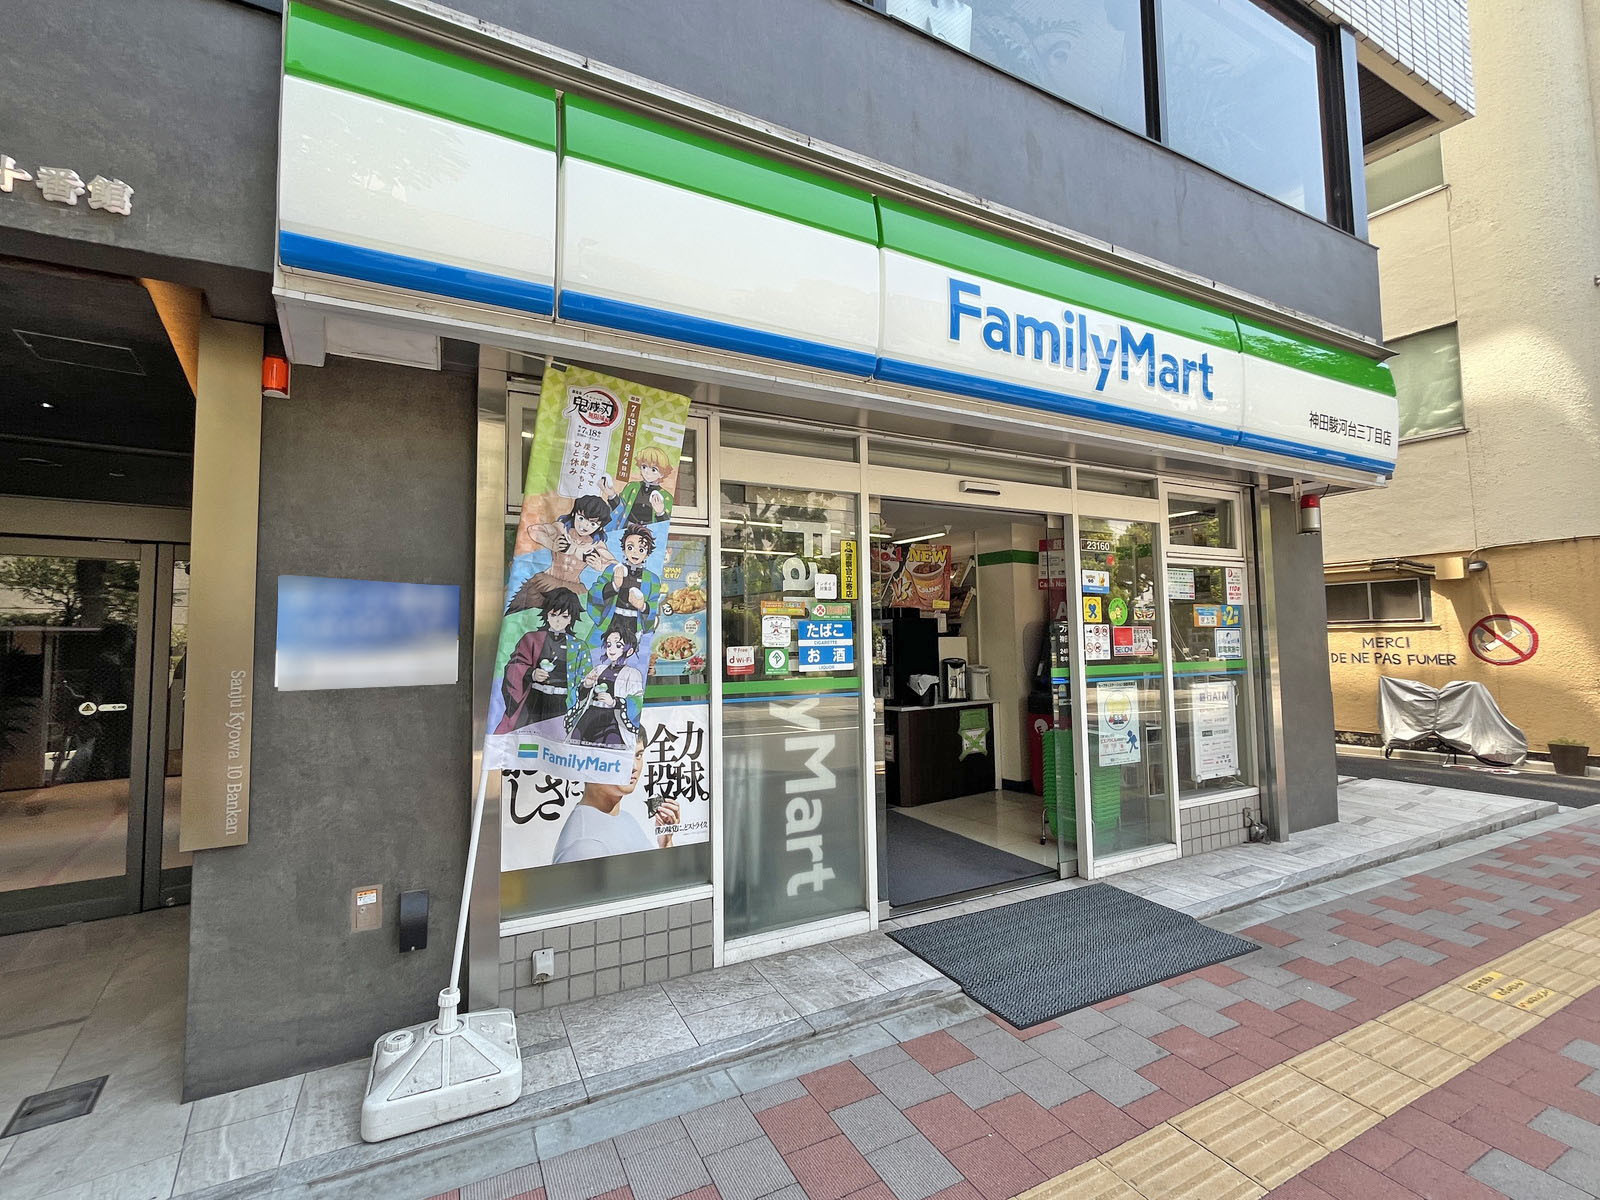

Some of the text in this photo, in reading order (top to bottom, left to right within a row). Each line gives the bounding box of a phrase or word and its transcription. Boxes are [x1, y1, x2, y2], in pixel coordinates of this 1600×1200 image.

[948, 277, 1215, 400] FamilyMart
[1308, 410, 1392, 446] 神田駿河台三丁目店
[568, 440, 587, 476] ひと休み
[908, 547, 948, 563] NEW
[1086, 541, 1110, 551] 23160
[806, 623, 845, 638] たばこ
[1362, 636, 1410, 649] MERCI
[736, 656, 752, 664] Wi-Fi
[807, 647, 846, 663] お酒
[1330, 652, 1457, 666] DE NE PAS FUMER
[230, 670, 246, 708] Sanju
[225, 711, 246, 760] Kyowa
[645, 720, 704, 764] 全力
[542, 747, 621, 773] FamilyMart
[643, 761, 710, 803] 投球。
[225, 782, 243, 836] Bankan
